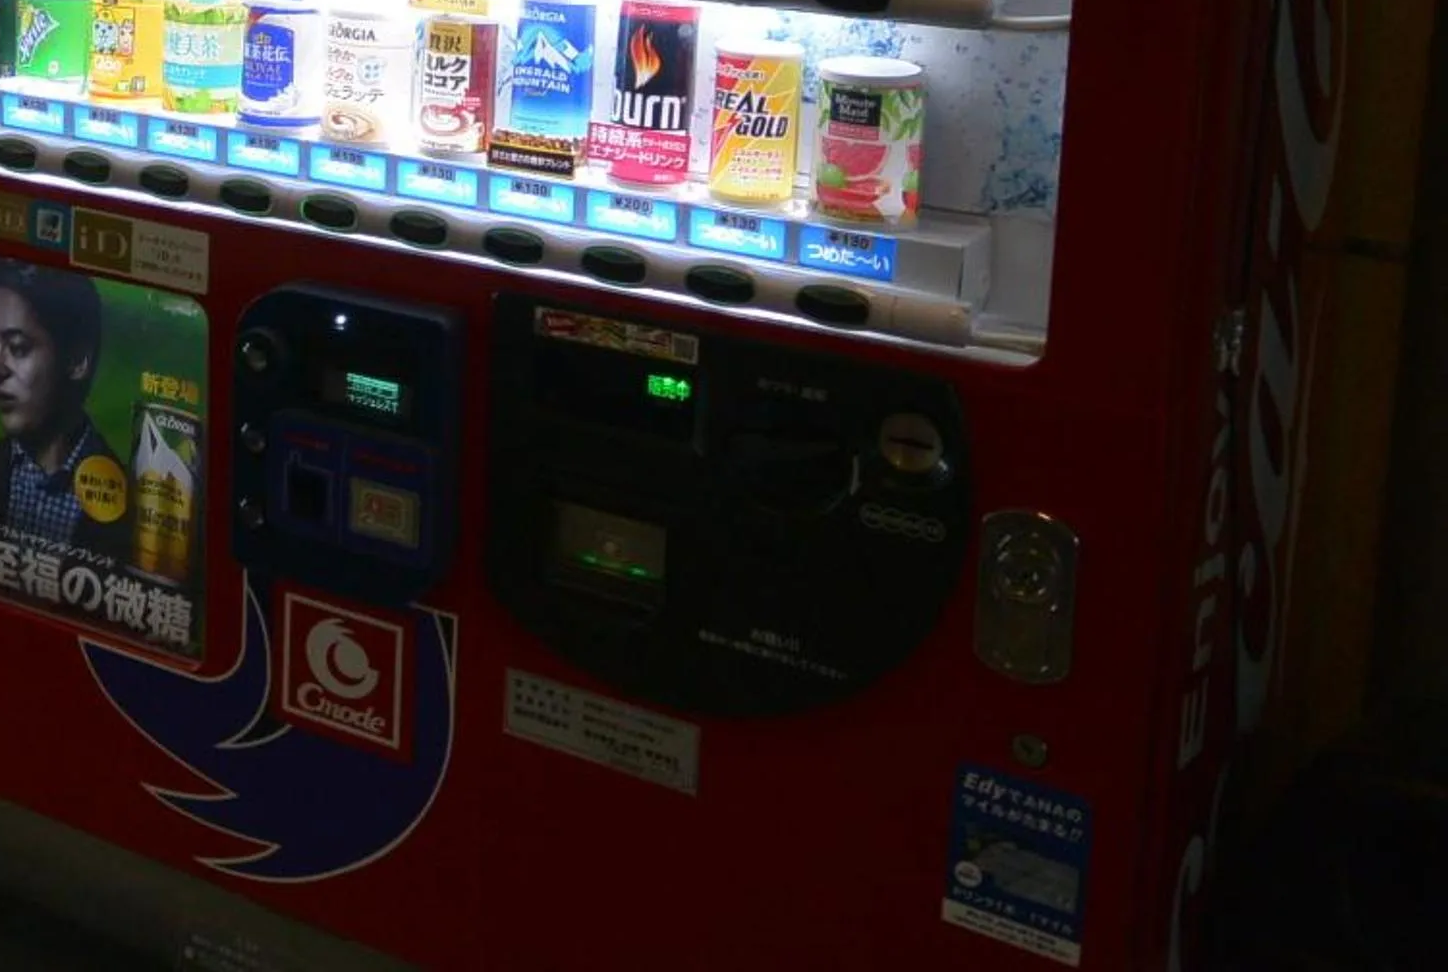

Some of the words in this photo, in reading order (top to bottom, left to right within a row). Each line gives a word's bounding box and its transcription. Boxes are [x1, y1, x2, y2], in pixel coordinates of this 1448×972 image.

[714, 90, 769, 116] REAL
[735, 115, 789, 139] GOLD
[589, 145, 686, 168] エナジードリンク
[79, 226, 129, 259] iD
[295, 683, 386, 735] Cmode
